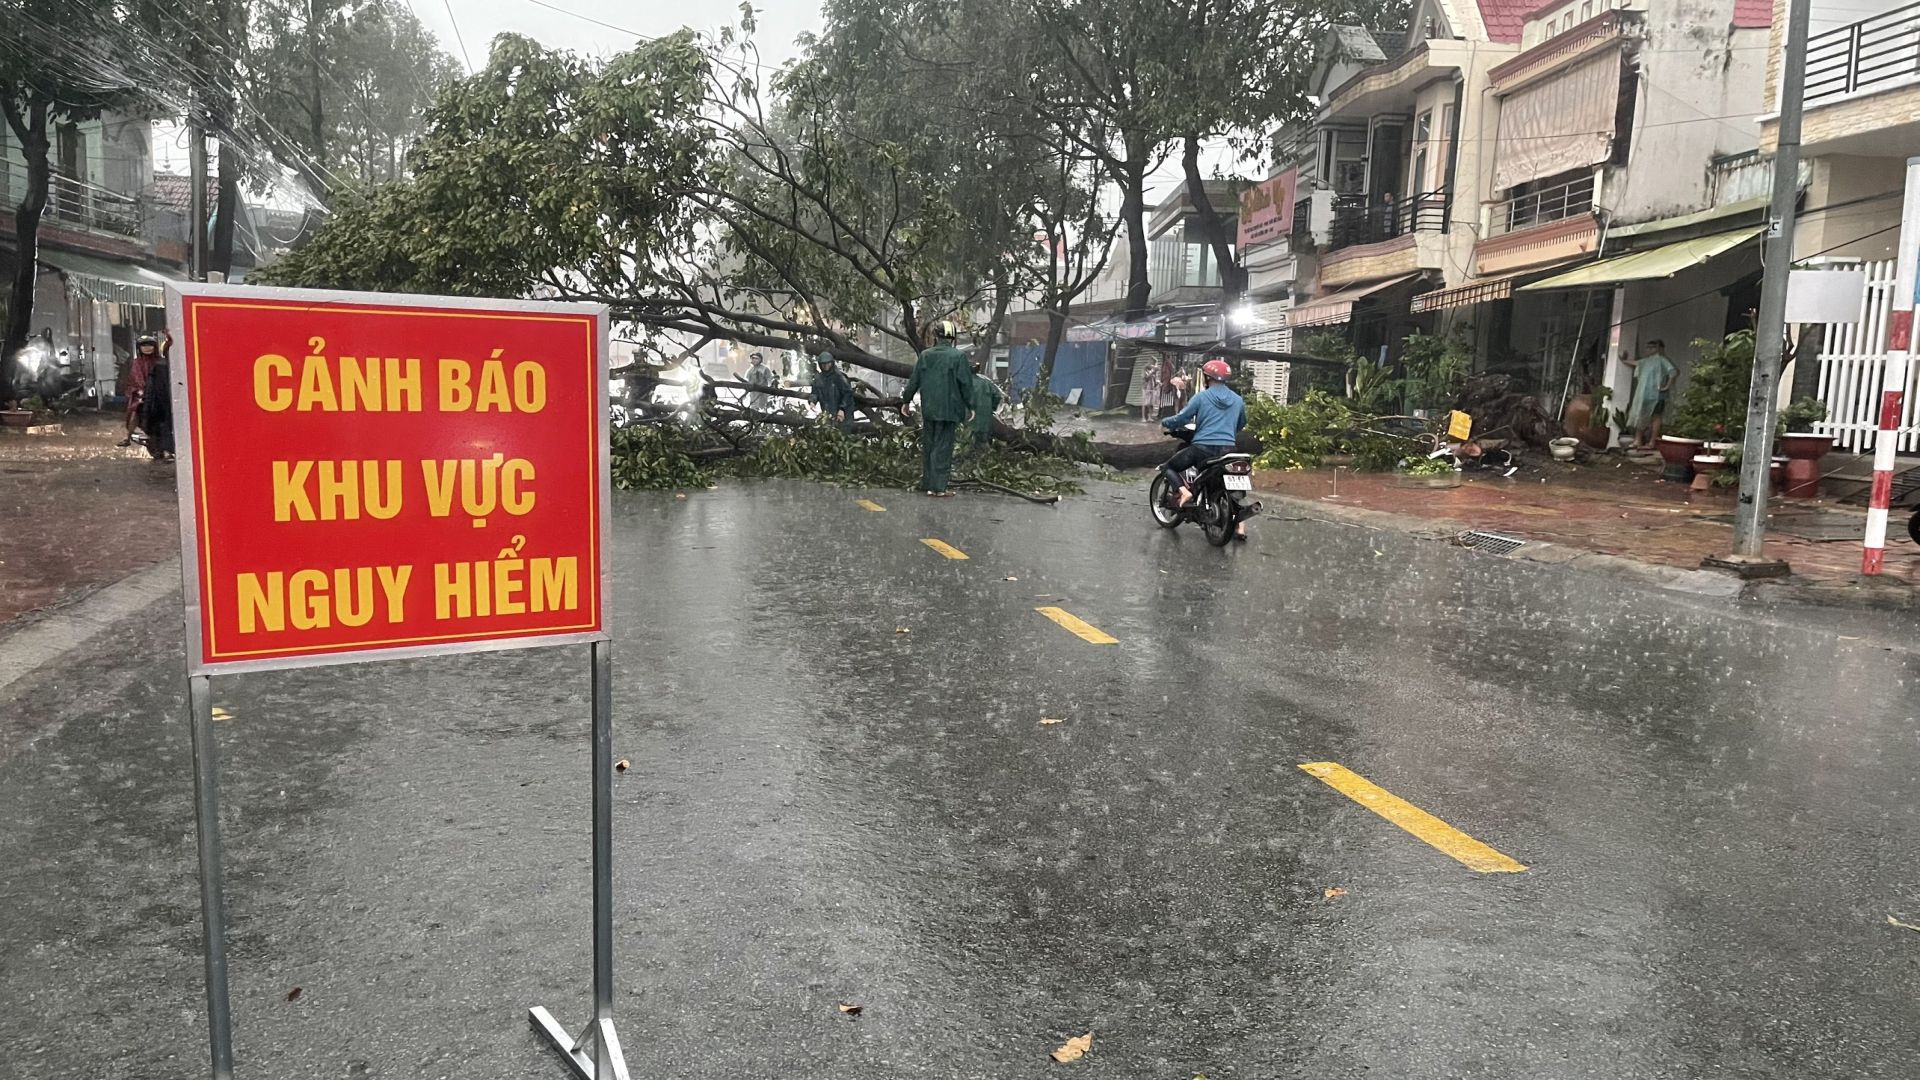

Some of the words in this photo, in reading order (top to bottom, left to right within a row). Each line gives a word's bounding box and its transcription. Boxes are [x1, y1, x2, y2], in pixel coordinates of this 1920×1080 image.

[253, 336, 421, 412] CẢNH
[438, 348, 547, 413] BÁO
[272, 459, 403, 522] KHU
[422, 453, 537, 529] VỰC
[237, 565, 413, 634] NGUY
[434, 535, 579, 620] HIỂM
